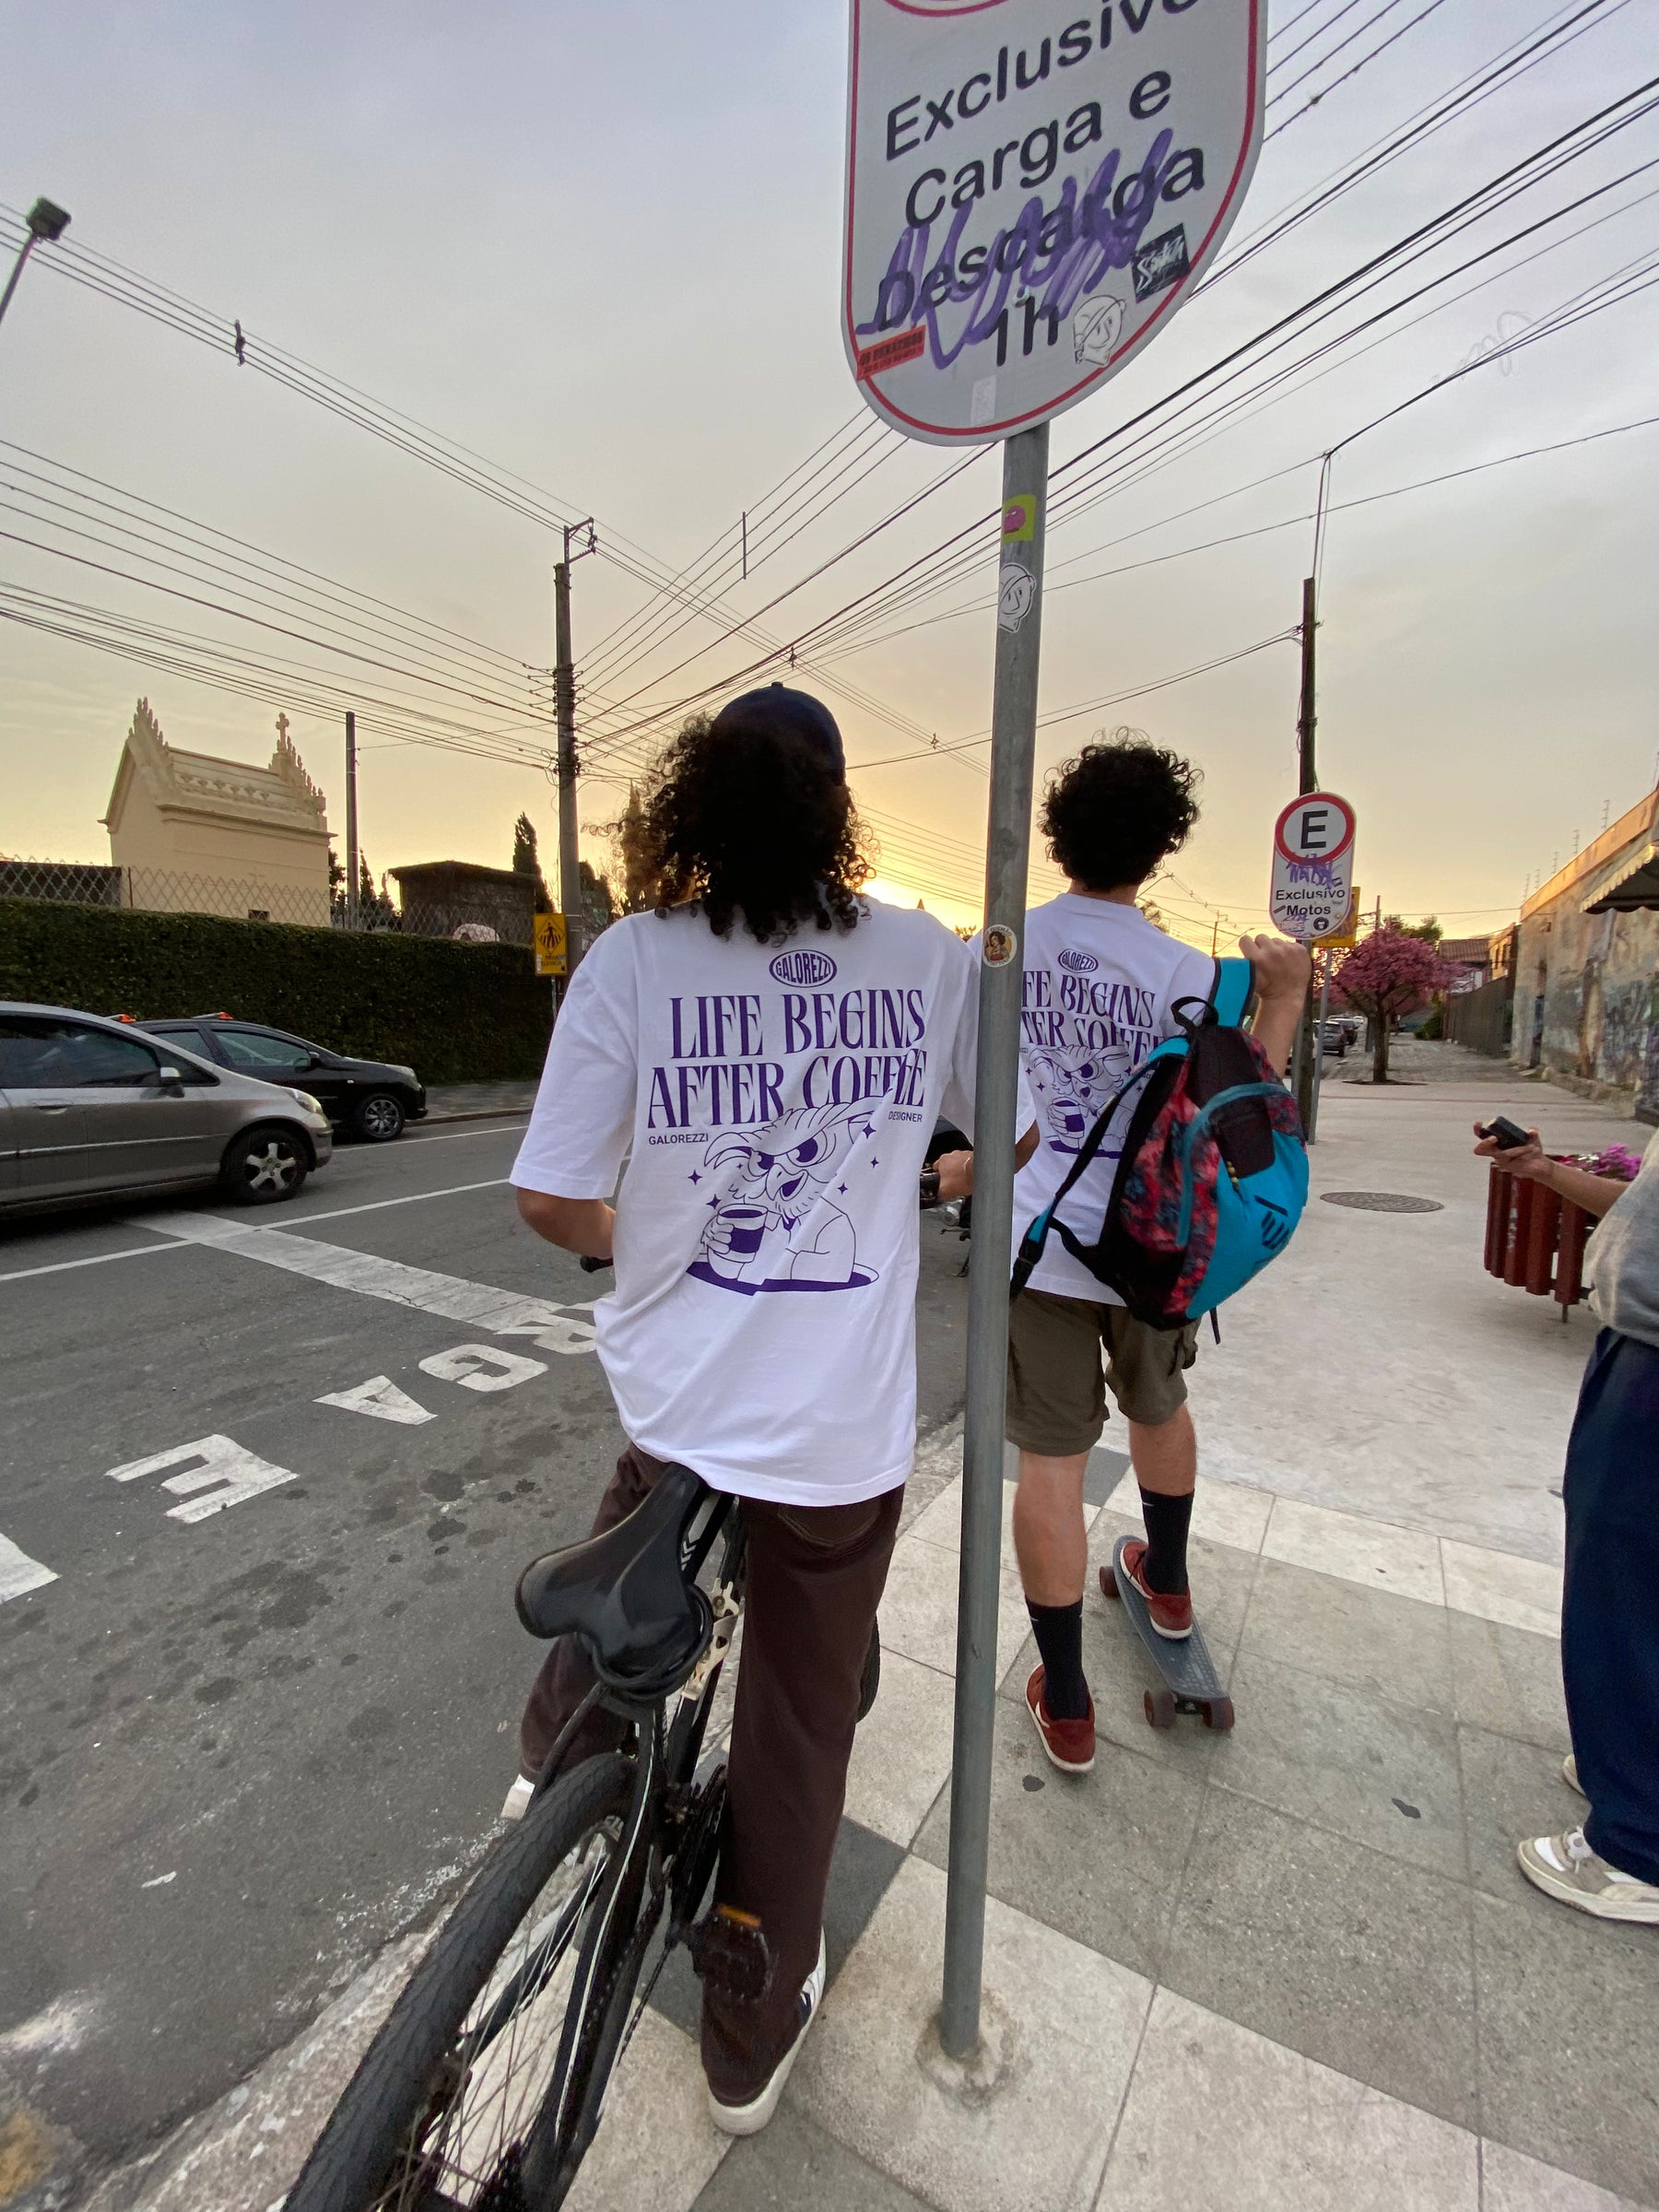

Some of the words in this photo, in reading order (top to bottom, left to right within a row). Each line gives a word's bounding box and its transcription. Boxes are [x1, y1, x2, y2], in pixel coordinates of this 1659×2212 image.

[906, 101, 1101, 229] Carga
[1129, 71, 1171, 120] e
[982, 296, 1059, 367] 1h
[1300, 809, 1328, 850] E
[1276, 888, 1346, 900] Exclusivo
[1287, 904, 1331, 916] Motos
[775, 950, 833, 984] GALOREZZI
[1022, 971, 1052, 1007] FE
[1061, 974, 1156, 1028] BEGINS
[671, 994, 763, 1059] LIFE
[782, 989, 925, 1054] BEGINS
[648, 1062, 784, 1129] AFTER
[803, 1049, 926, 1109] COFFEE
[888, 1111, 923, 1123] DESIGNER
[649, 1133, 708, 1145] GALOREZZI
